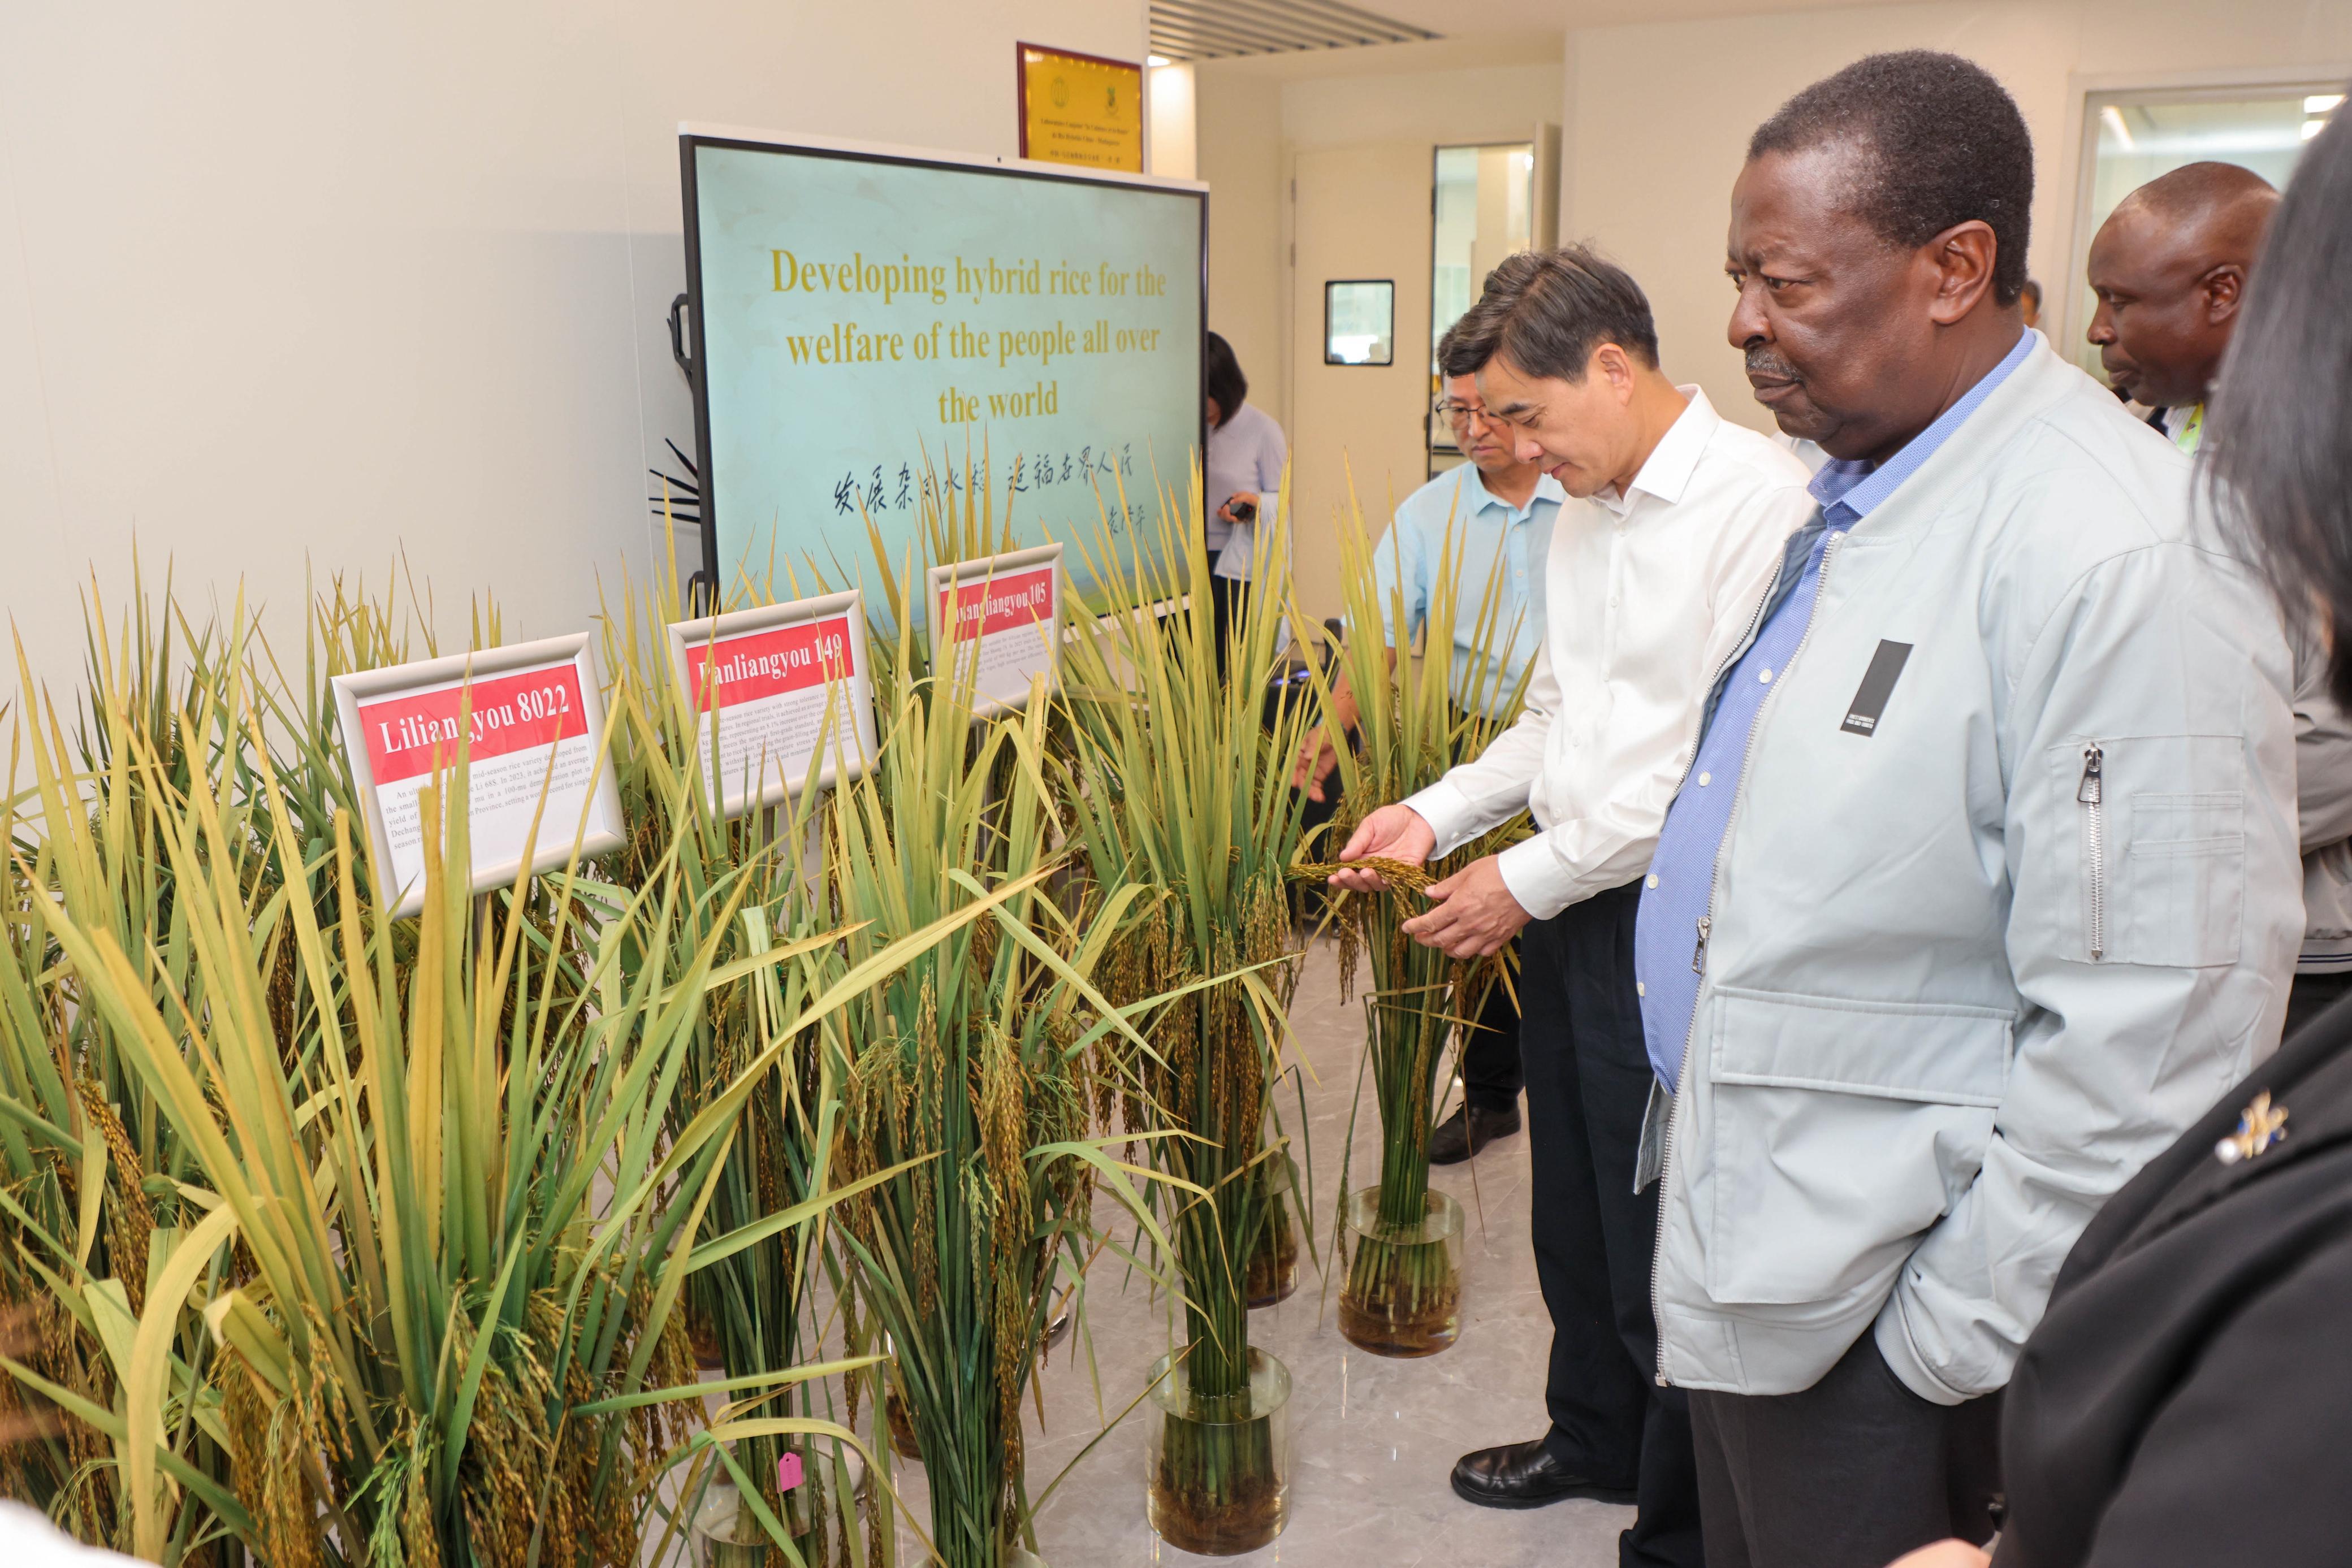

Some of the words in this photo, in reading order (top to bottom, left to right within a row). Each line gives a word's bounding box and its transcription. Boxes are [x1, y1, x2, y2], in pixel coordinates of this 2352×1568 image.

[770, 249, 947, 305] Developing
[955, 256, 1041, 304] hybrid
[1049, 259, 1092, 295] rice
[1098, 261, 1130, 296] for
[1135, 263, 1167, 297] the
[786, 322, 905, 366] welfare
[914, 321, 944, 360] of
[949, 321, 991, 358] the
[997, 321, 1076, 367] people
[1083, 319, 1109, 353] all
[1116, 327, 1161, 353] over
[938, 385, 981, 425] the
[988, 380, 1058, 418] world
[1030, 582, 1045, 604] 105
[814, 633, 842, 662] 149
[517, 685, 569, 722] 8022
[742, 717, 760, 726] regional
[781, 706, 800, 716] achieved
[729, 727, 758, 738] representing
[386, 805, 397, 814] the
[485, 779, 498, 788] 68S.
[568, 756, 589, 765] average
[472, 766, 507, 779] mid-season
[522, 757, 542, 766] variety
[388, 815, 406, 828] yield
[410, 811, 418, 820] of
[504, 785, 526, 794] 100-mu
[571, 767, 582, 777] plot
[391, 825, 421, 837] Dechang
[475, 803, 504, 813] Province,
[505, 796, 525, 805] setting
[394, 838, 416, 850] season
